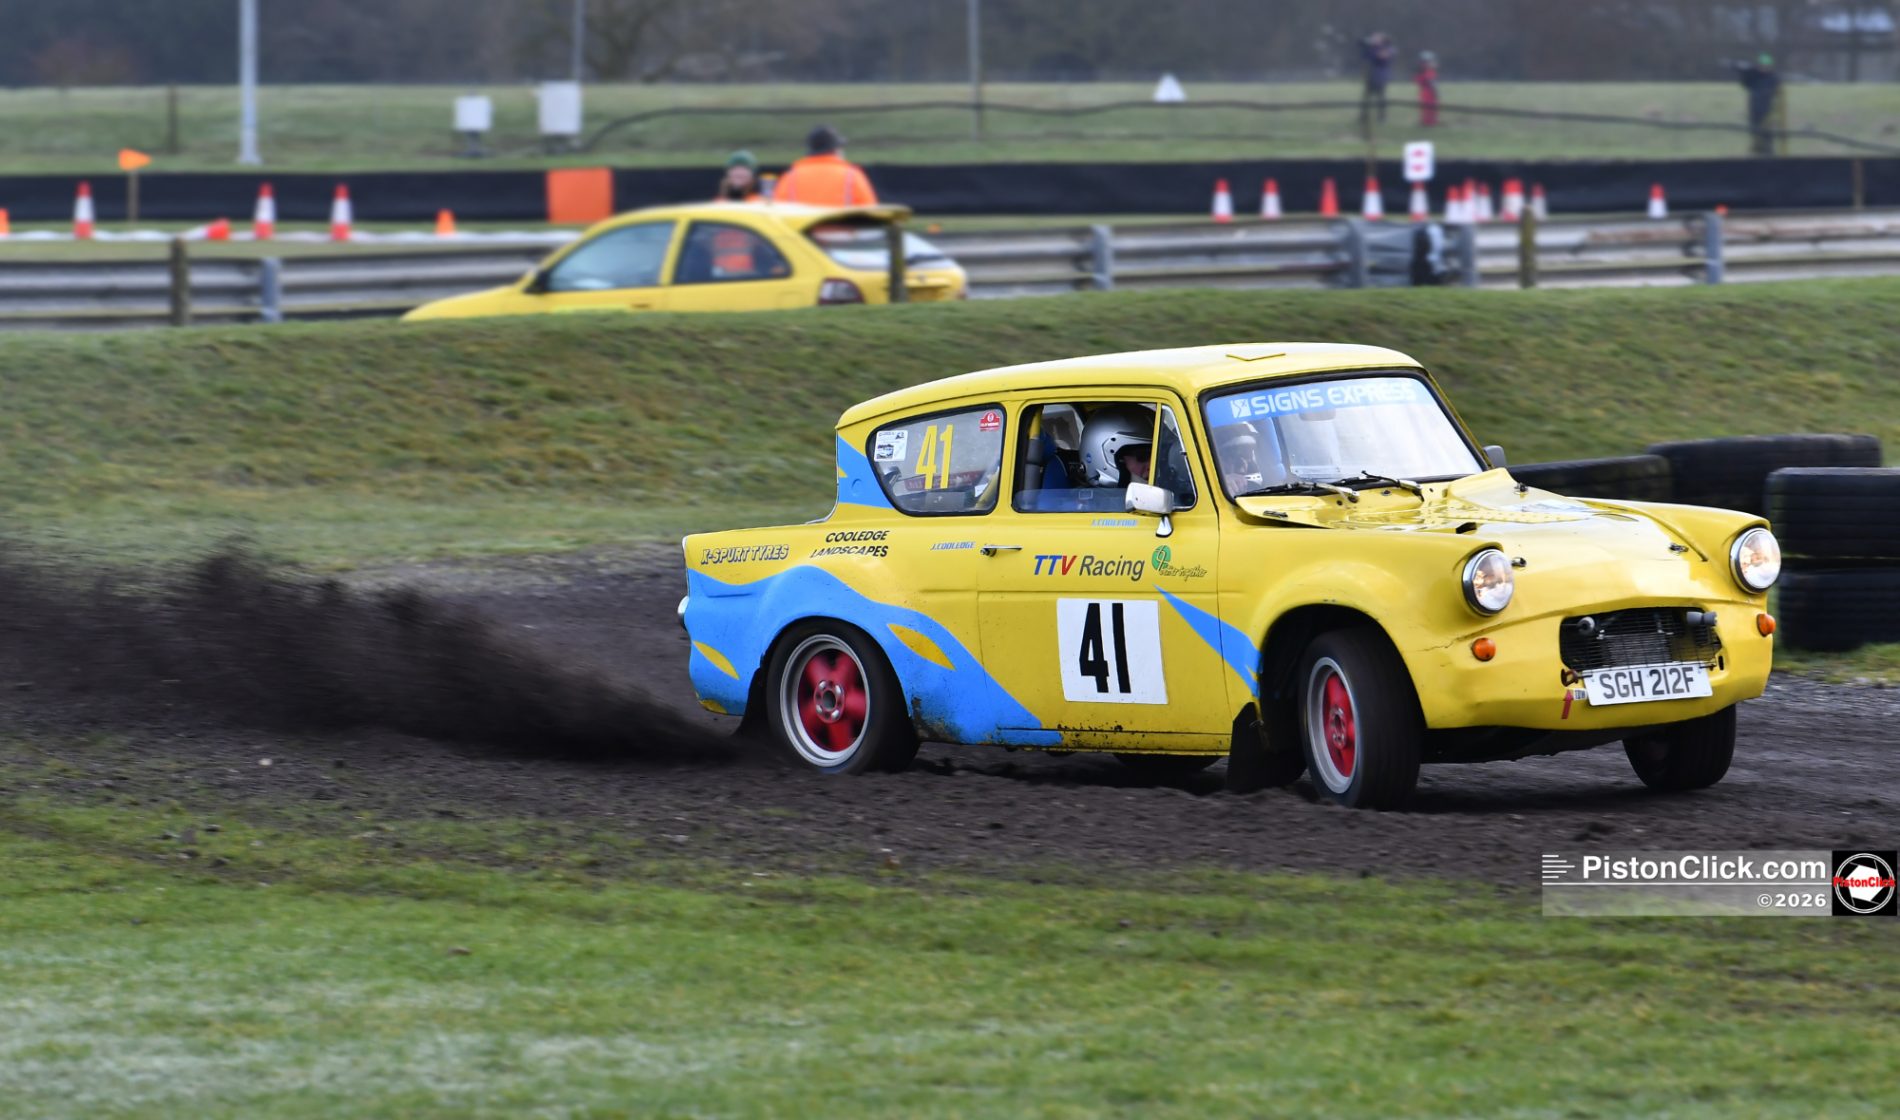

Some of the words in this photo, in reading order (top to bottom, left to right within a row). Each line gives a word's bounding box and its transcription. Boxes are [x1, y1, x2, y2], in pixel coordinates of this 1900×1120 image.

[1251, 389, 1324, 415] SIGNS
[1327, 382, 1416, 405] EXPRESS
[915, 424, 954, 489] 41
[810, 545, 889, 558] LANDSCAPES
[825, 531, 890, 543] COOLEDGE
[701, 546, 751, 565] X-SPURT
[750, 544, 790, 561] TYRES
[1034, 555, 1077, 575] TTV
[1079, 555, 1145, 582] Racing
[1079, 603, 1131, 693] 41
[1599, 671, 1645, 699] SGH
[1649, 667, 1693, 696] 212F
